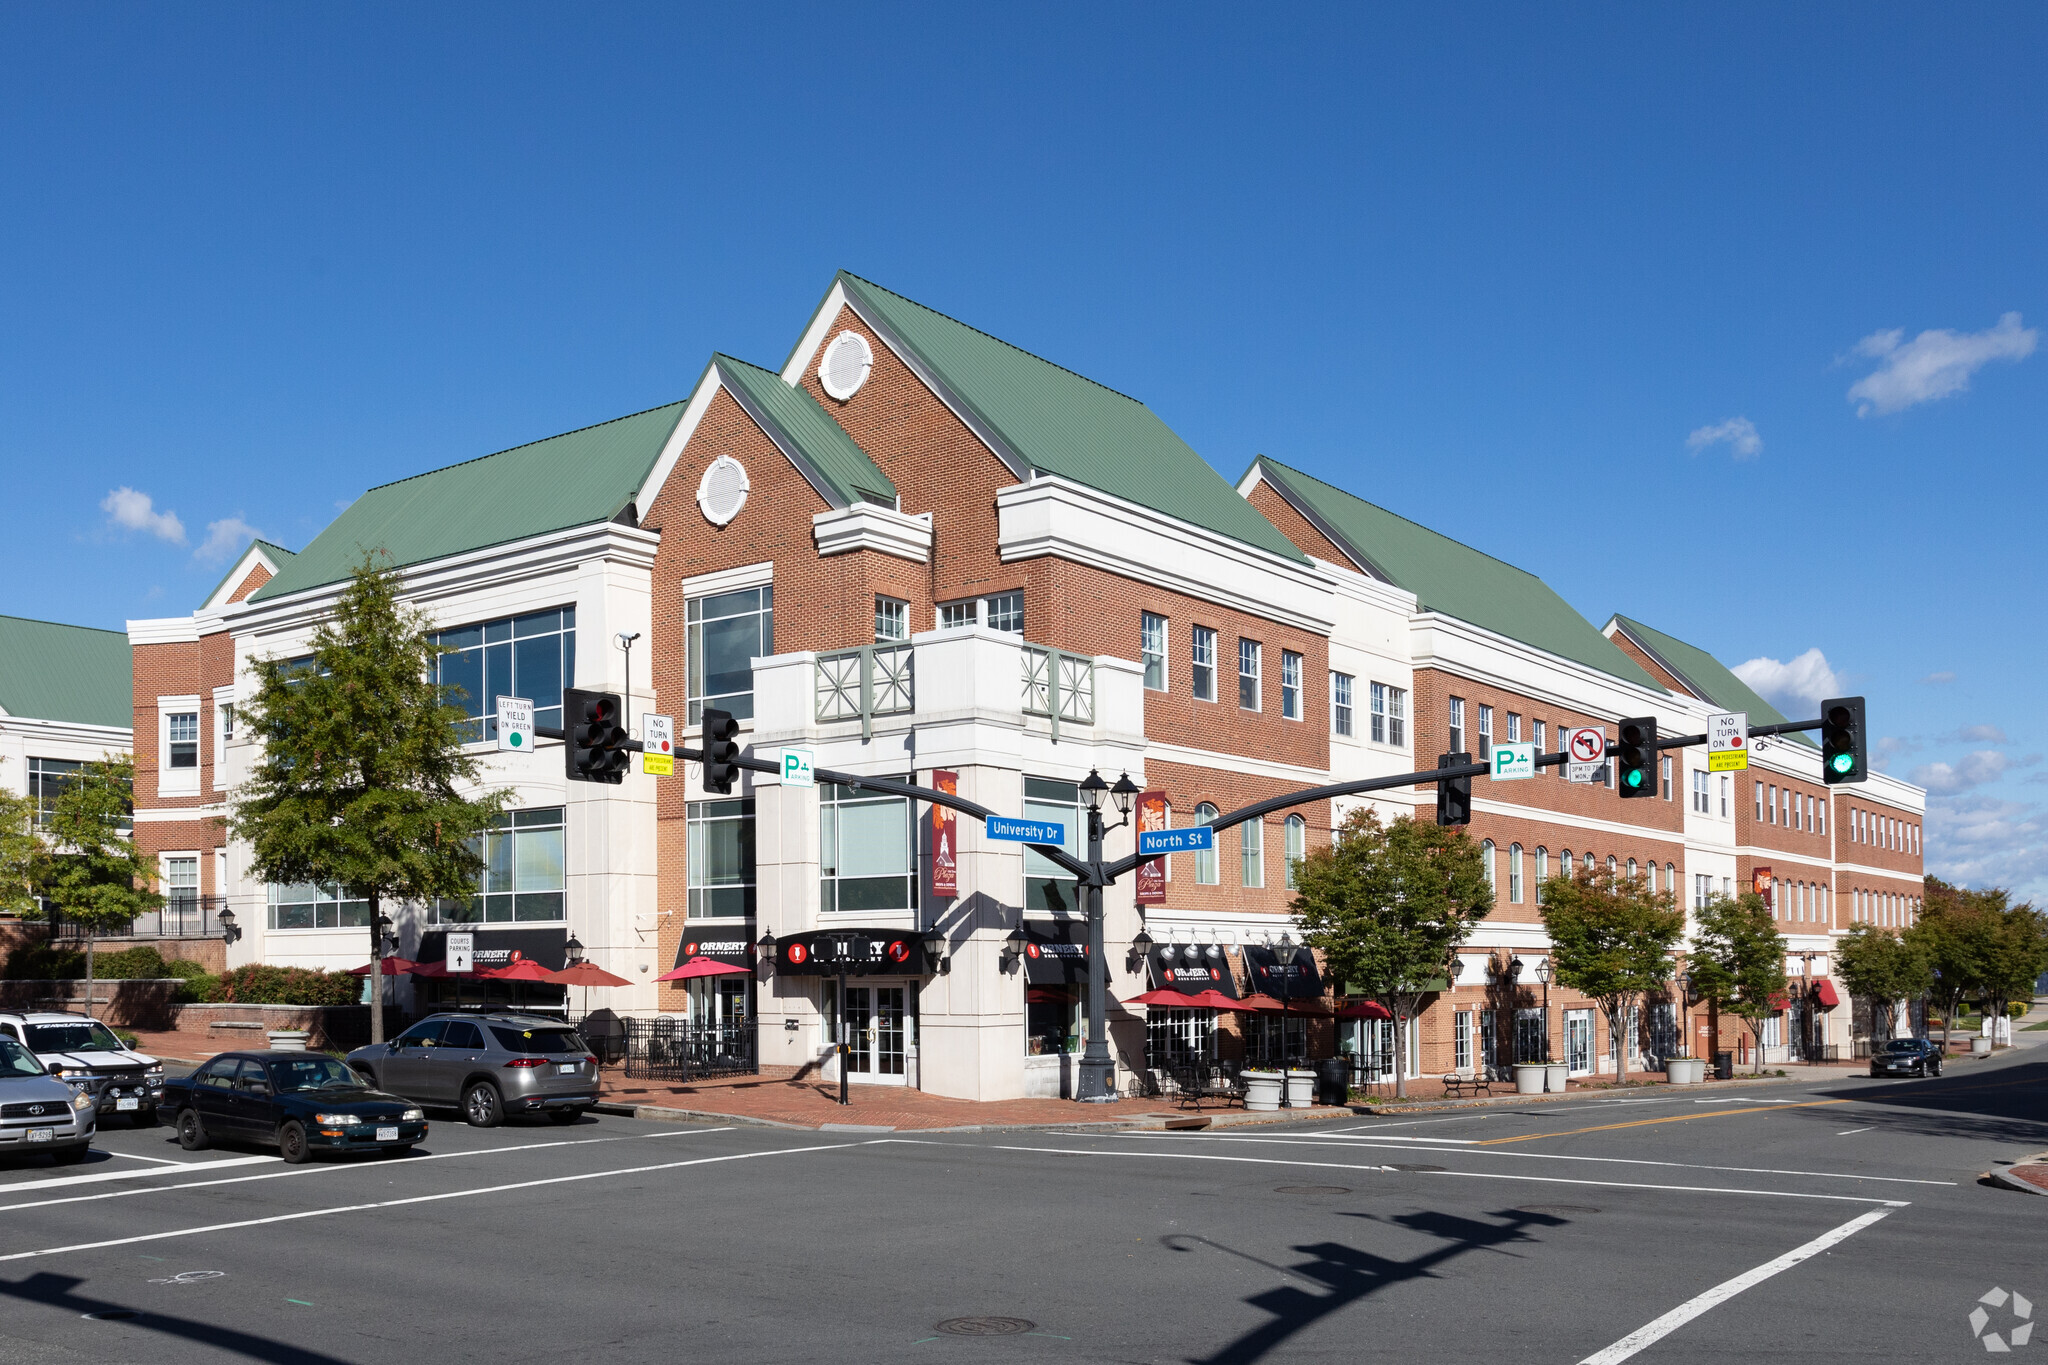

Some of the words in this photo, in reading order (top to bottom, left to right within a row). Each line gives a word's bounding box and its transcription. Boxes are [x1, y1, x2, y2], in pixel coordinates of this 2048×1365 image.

[506, 711, 526, 721] YIELD
[512, 722, 531, 730] GREEN
[652, 720, 664, 728] NO
[1720, 717, 1735, 726] NO
[650, 730, 668, 739] TURN
[1716, 728, 1739, 737] TURN
[647, 741, 657, 749] ON
[1712, 740, 1725, 748] ON
[993, 821, 1044, 840] University
[1046, 826, 1058, 839] Dr
[1146, 832, 1183, 849] North
[1188, 832, 1203, 846] St
[700, 941, 748, 950] ORNERY
[1039, 943, 1084, 954] ORNERY
[1174, 967, 1210, 977] ORNERY
